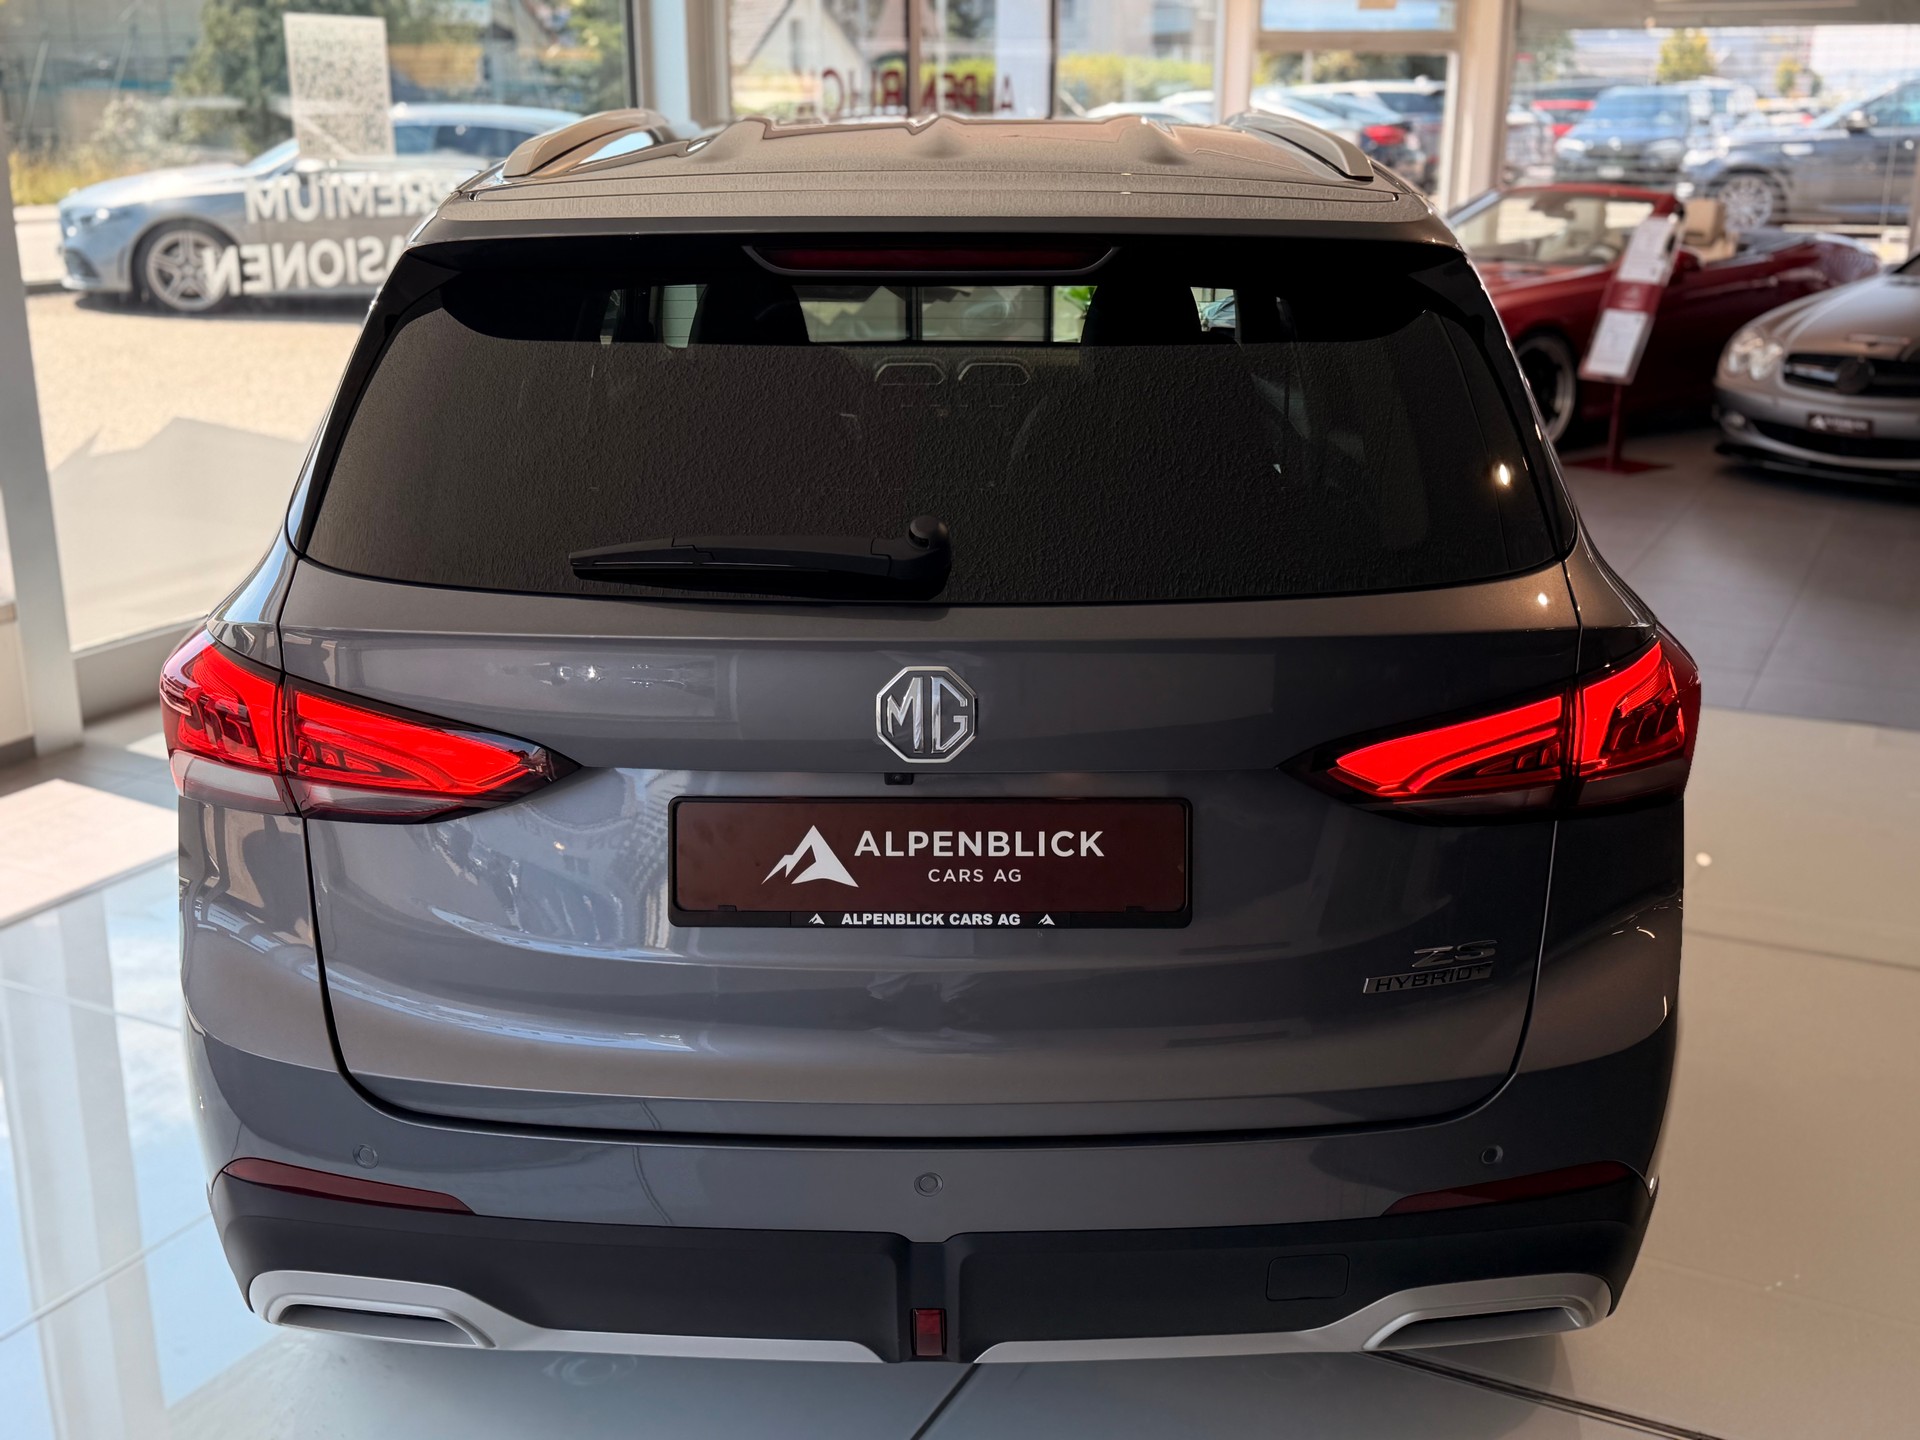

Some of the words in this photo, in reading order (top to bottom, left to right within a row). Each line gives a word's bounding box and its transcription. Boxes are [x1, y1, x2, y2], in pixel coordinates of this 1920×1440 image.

[886, 676, 968, 754] MG
[855, 831, 1104, 857] ALPENBLICK
[928, 869, 983, 882] CARS
[994, 869, 1021, 882] AG
[842, 914, 944, 925] ALPENBLICK
[950, 914, 992, 925] CARS
[998, 914, 1020, 925] AG
[1411, 939, 1498, 968] ZS
